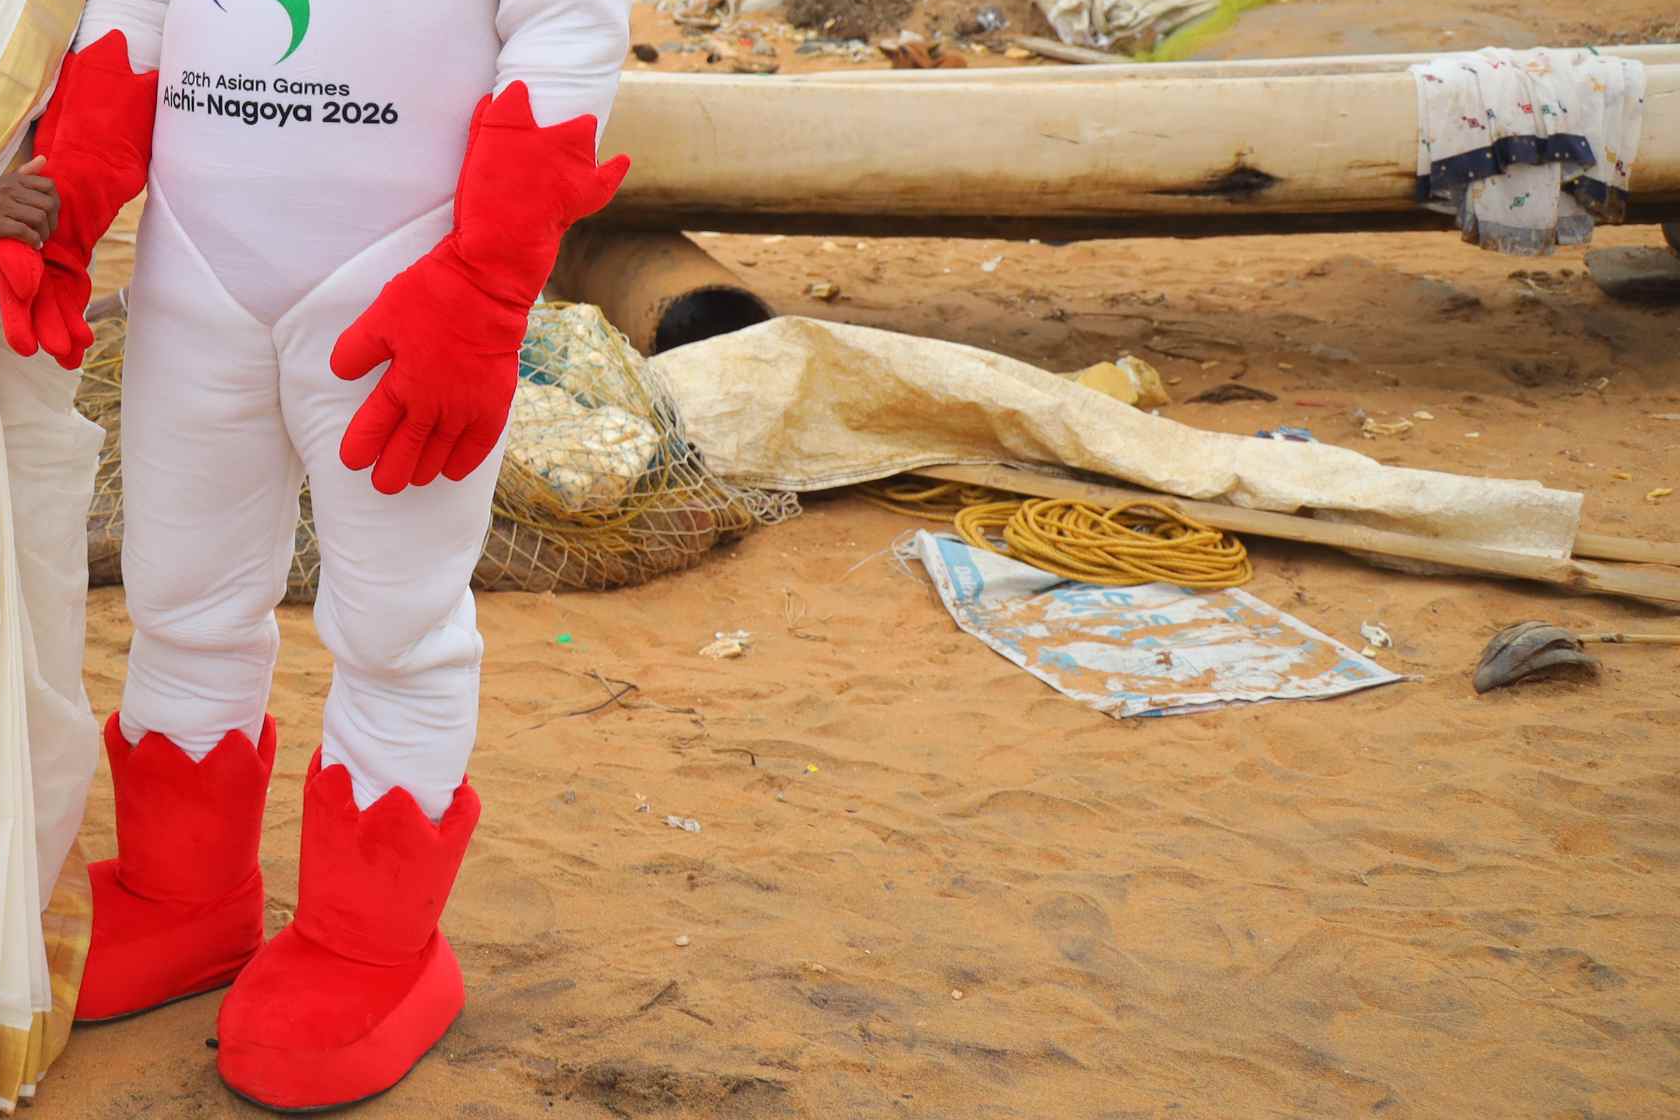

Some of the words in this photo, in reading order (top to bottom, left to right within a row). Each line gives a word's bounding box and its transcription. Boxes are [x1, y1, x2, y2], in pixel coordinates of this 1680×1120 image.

[182, 70, 211, 88] 20th
[215, 73, 267, 92] Asian
[272, 77, 351, 97] Games
[163, 84, 313, 128] Aichi-Nagoya
[321, 101, 399, 125] 2026
